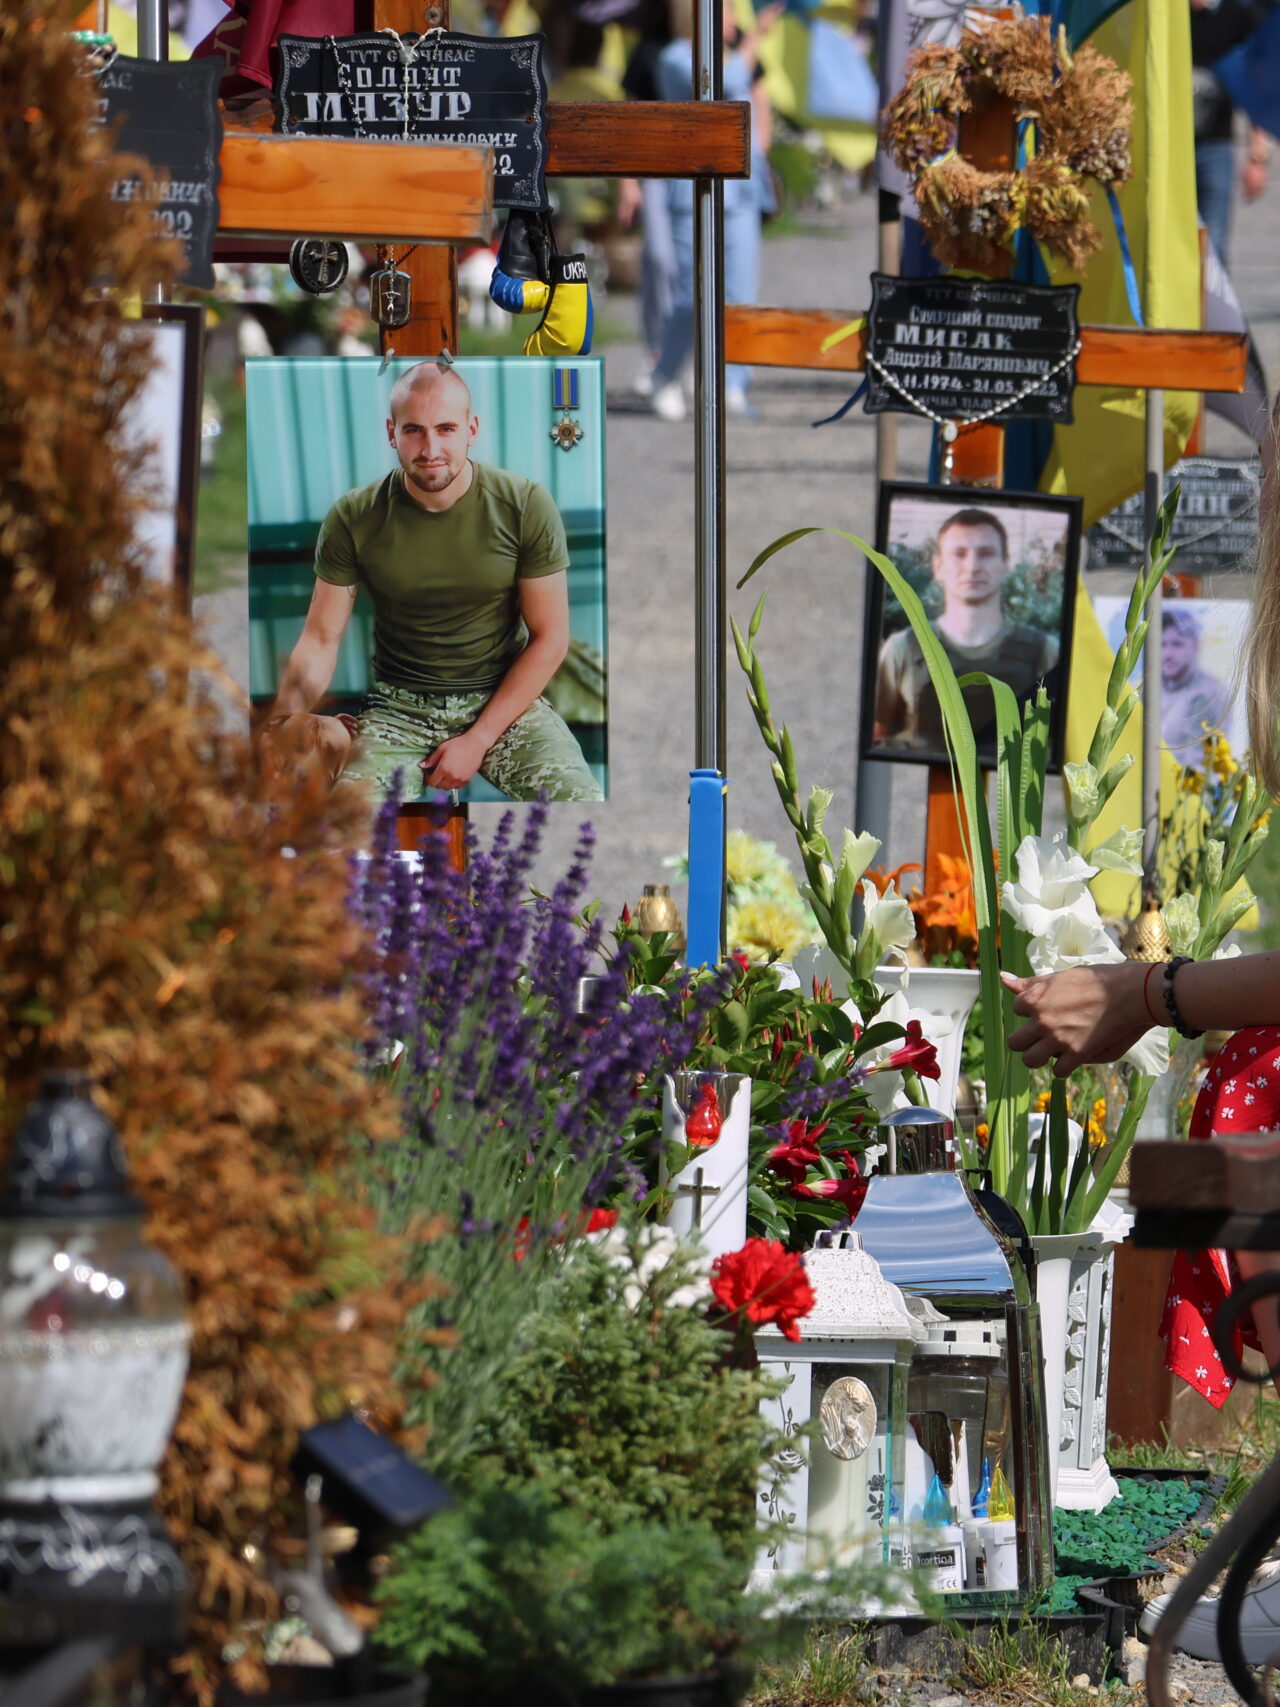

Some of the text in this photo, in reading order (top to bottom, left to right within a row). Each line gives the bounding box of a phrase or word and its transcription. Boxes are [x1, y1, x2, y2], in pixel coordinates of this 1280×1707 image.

[347, 49, 477, 64] ТУТ СЧИВАЄ
[303, 91, 473, 122] МАЗУР
[973, 378, 1060, 397] 21.05.222
